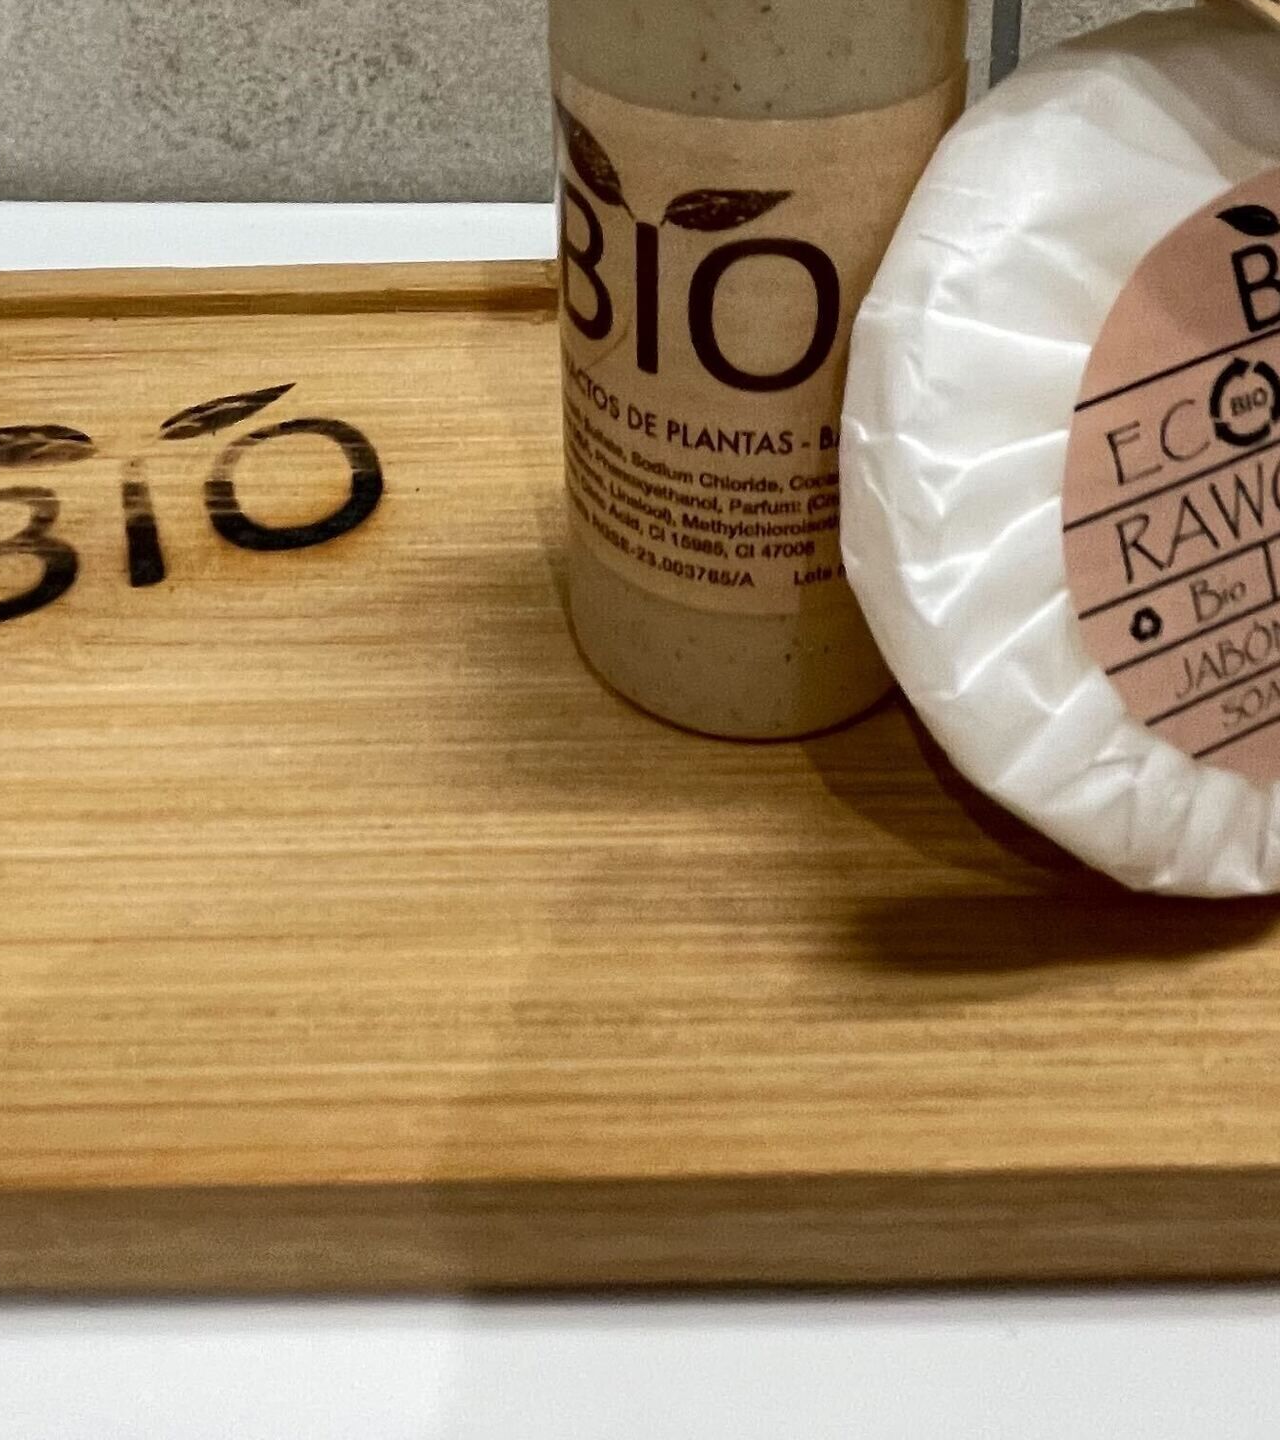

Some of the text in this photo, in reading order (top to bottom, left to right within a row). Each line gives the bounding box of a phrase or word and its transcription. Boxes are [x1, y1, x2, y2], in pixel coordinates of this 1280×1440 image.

[562, 172, 839, 393] BIO
[1230, 387, 1269, 417] BIO
[627, 403, 658, 439] DE
[666, 419, 794, 456] PLANTAS
[699, 472, 784, 494] Chloride,
[1189, 576, 1246, 623] Bio
